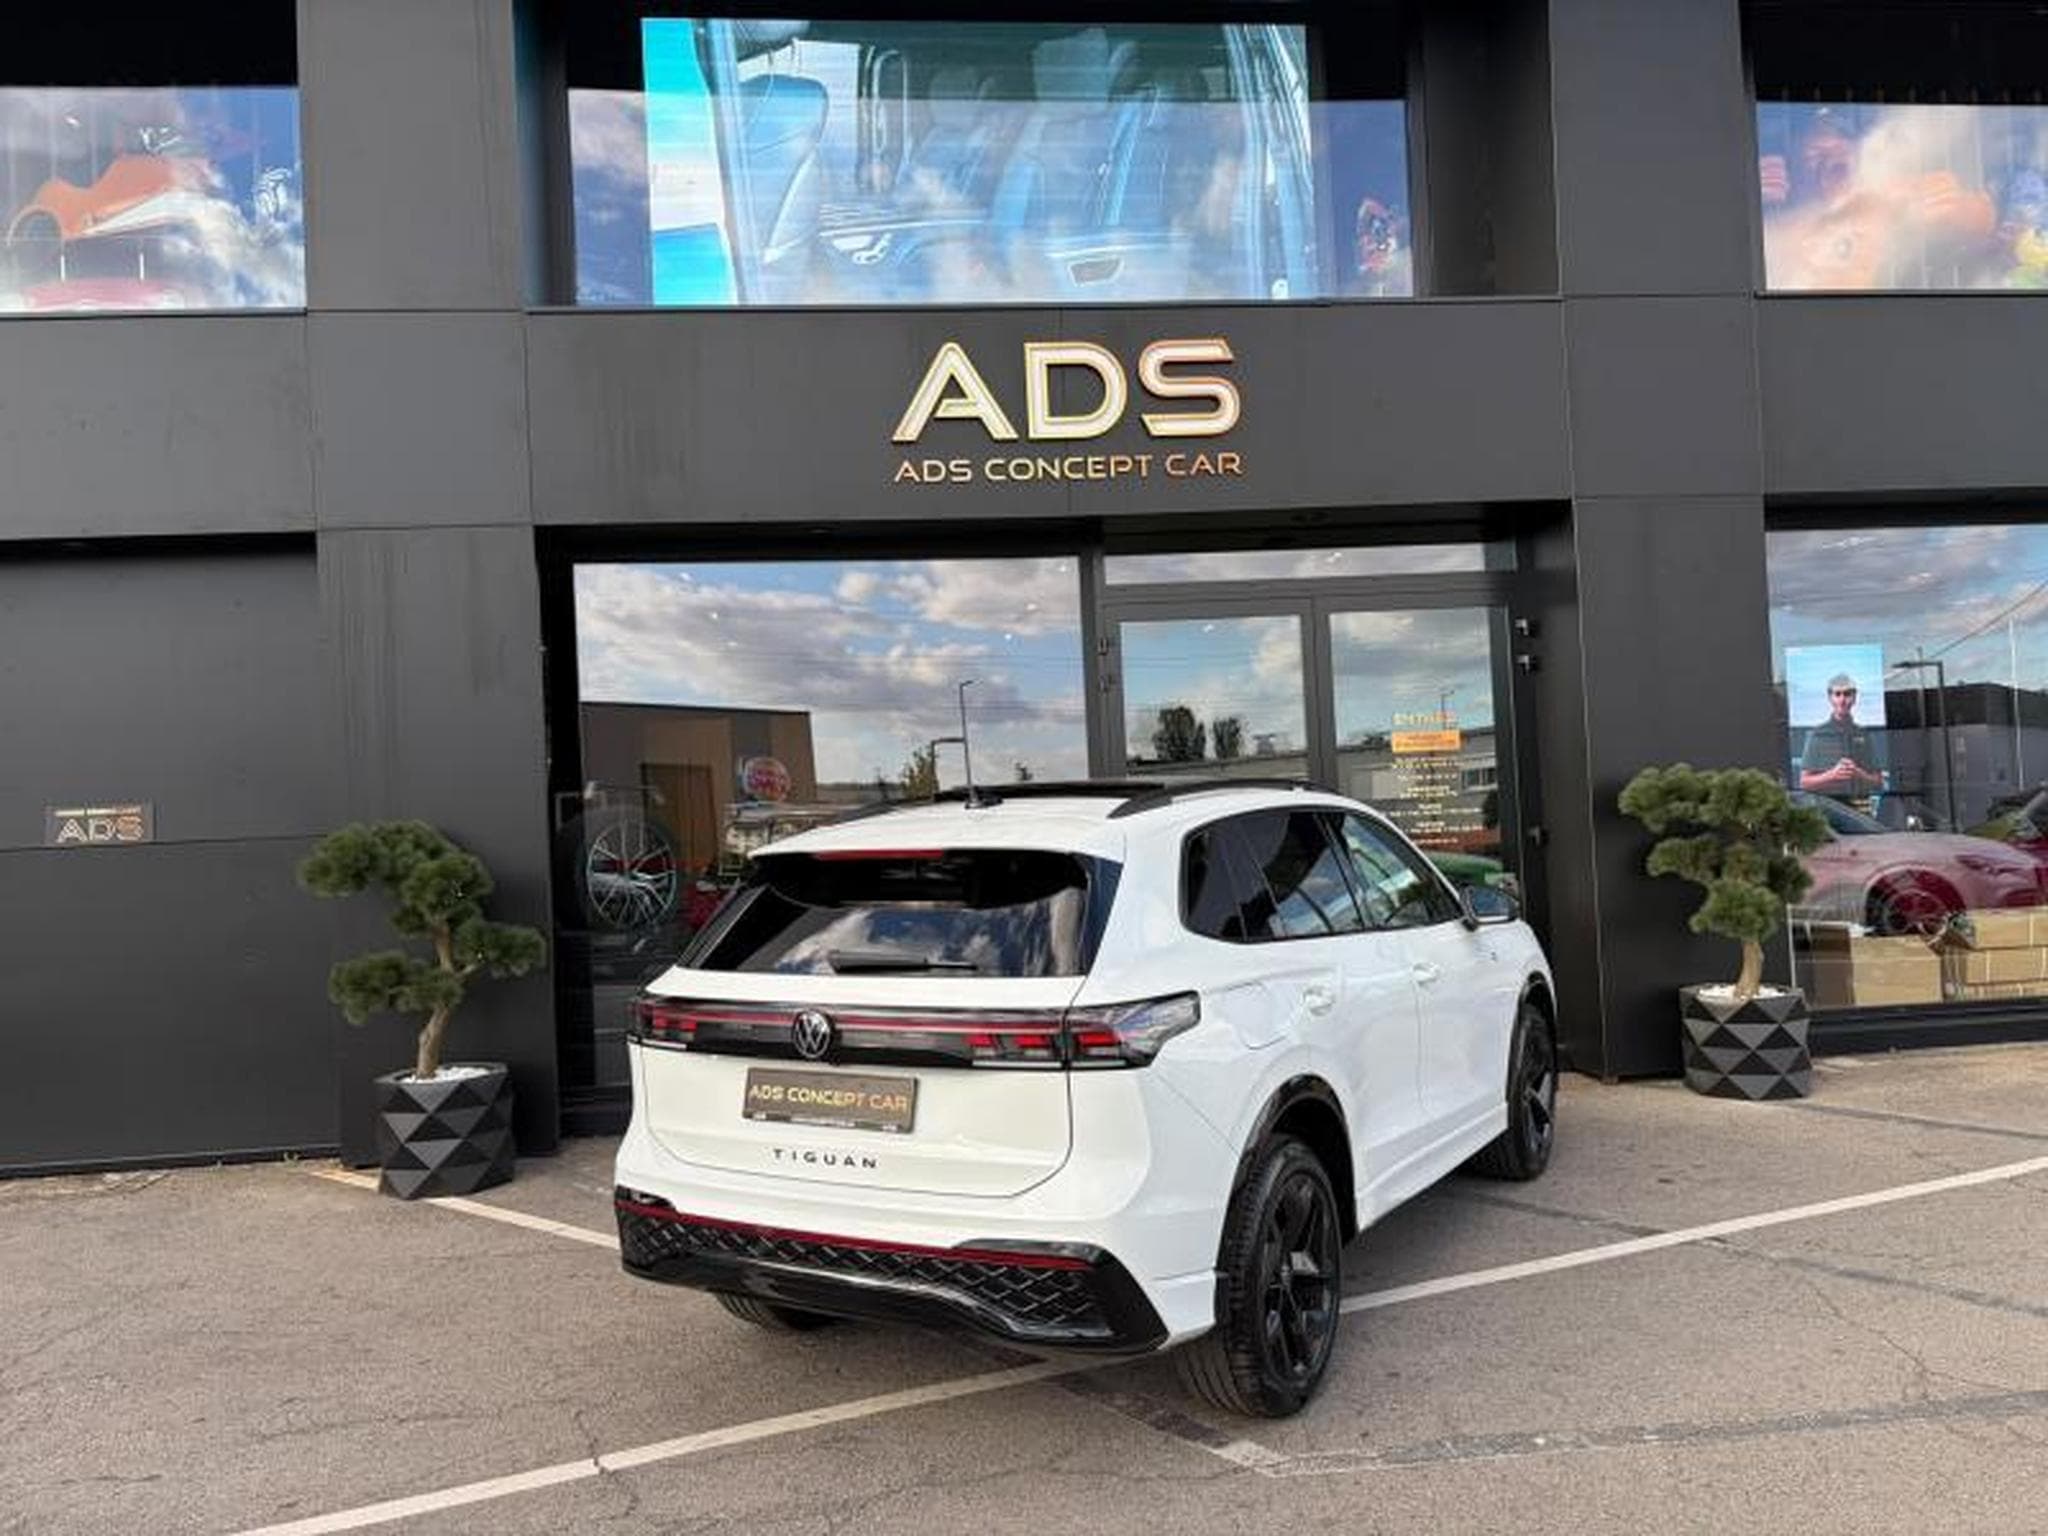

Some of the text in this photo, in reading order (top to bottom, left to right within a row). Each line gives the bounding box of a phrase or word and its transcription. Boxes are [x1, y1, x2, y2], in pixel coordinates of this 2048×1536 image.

[892, 337, 1241, 443] ADS
[894, 451, 1243, 484] ADS CONCEPT CAR
[56, 816, 144, 843] ADS
[750, 1084, 908, 1114] ADS CONCEPT CAR
[773, 1148, 877, 1169] TIGUAN
